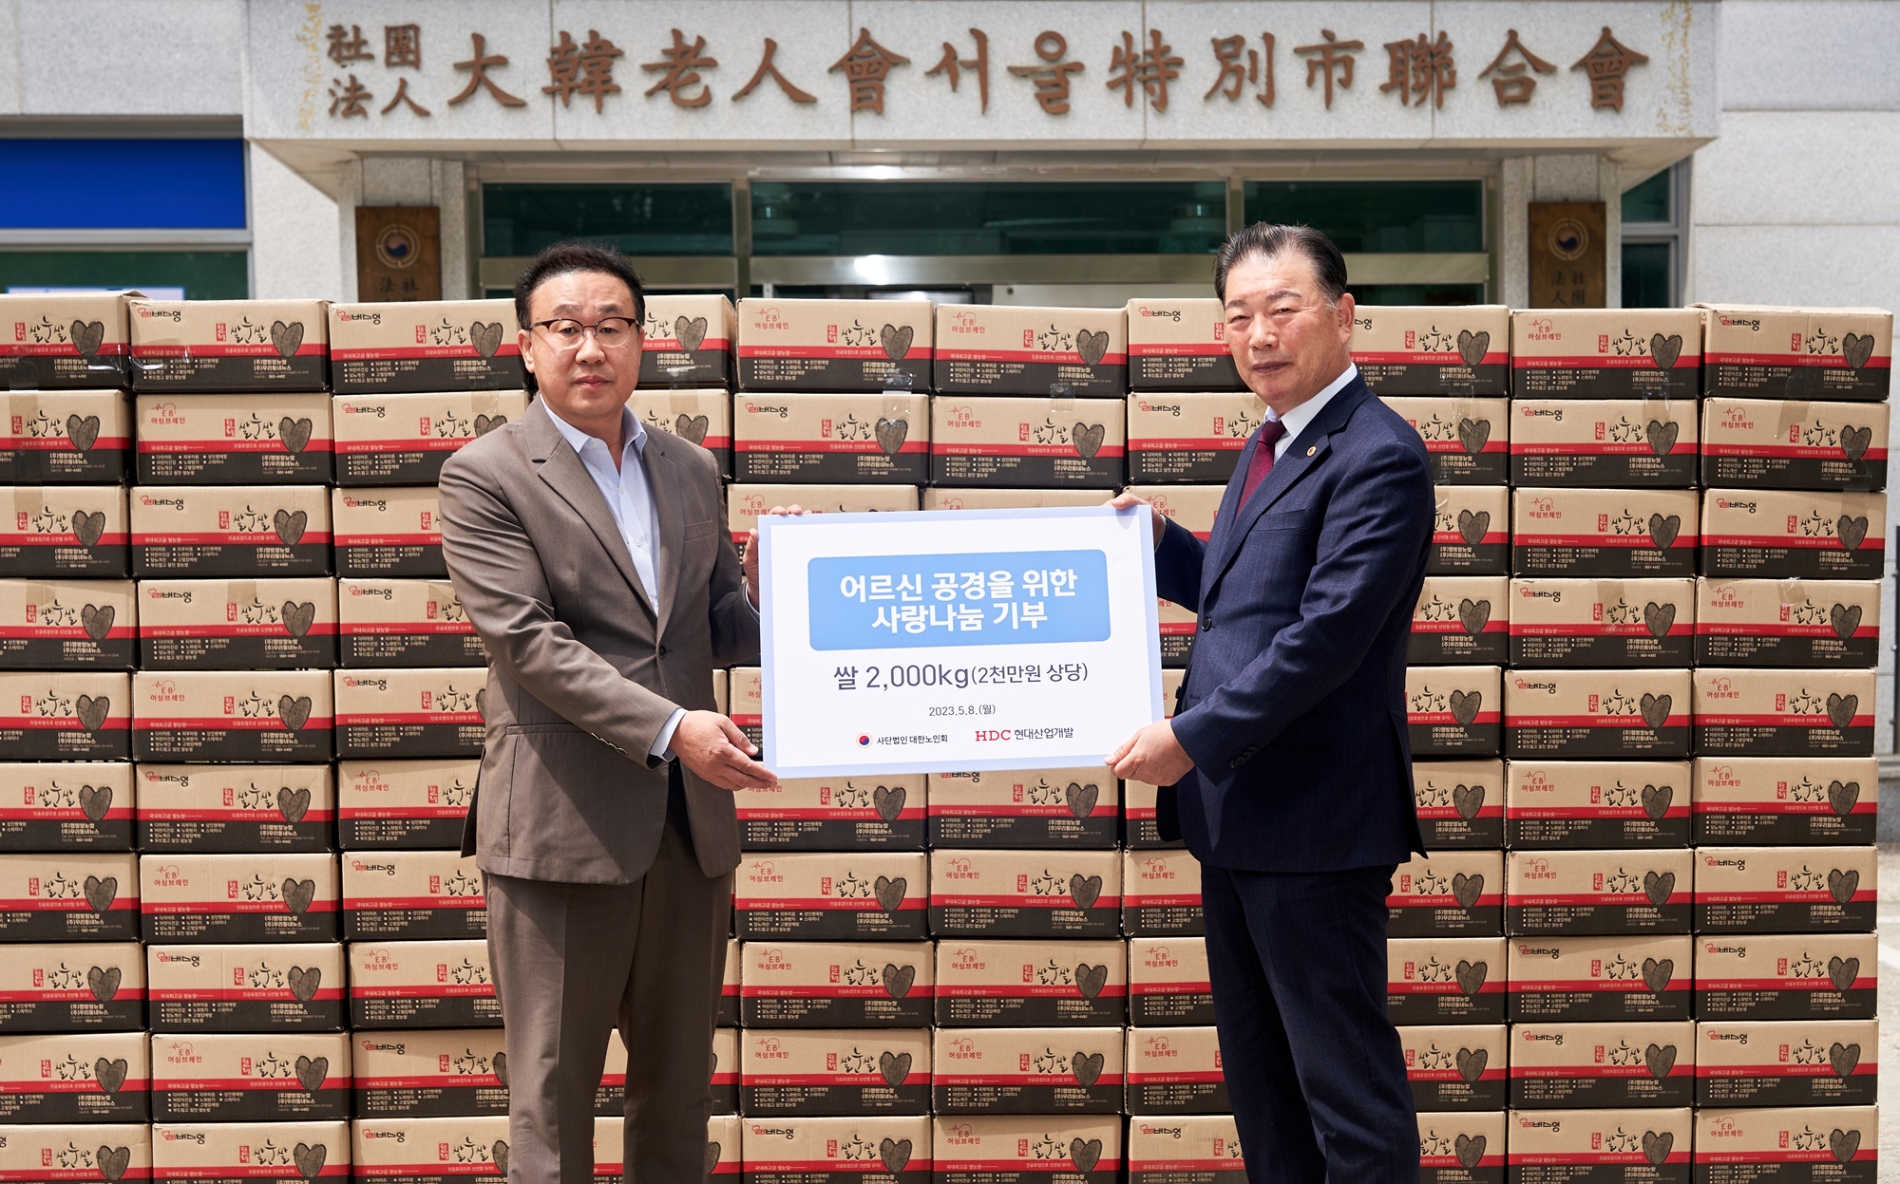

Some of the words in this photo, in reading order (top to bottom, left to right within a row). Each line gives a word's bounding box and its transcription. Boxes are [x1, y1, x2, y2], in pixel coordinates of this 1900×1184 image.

[329, 75, 430, 118] 法人
[840, 574, 922, 602] 어르신
[932, 570, 1013, 601] 공경을
[1022, 568, 1078, 597] 위한
[872, 603, 985, 634] 사랑나눔
[993, 601, 1048, 630] 기부
[833, 666, 859, 690] 쌀
[1046, 662, 1088, 684] 상당)
[929, 704, 996, 717] 2023.5.8.(월)
[877, 735, 907, 745] 사단법인
[909, 734, 948, 745] 대한노인회
[975, 730, 1011, 742] HDC
[1014, 727, 1074, 741] 현대산업개발
